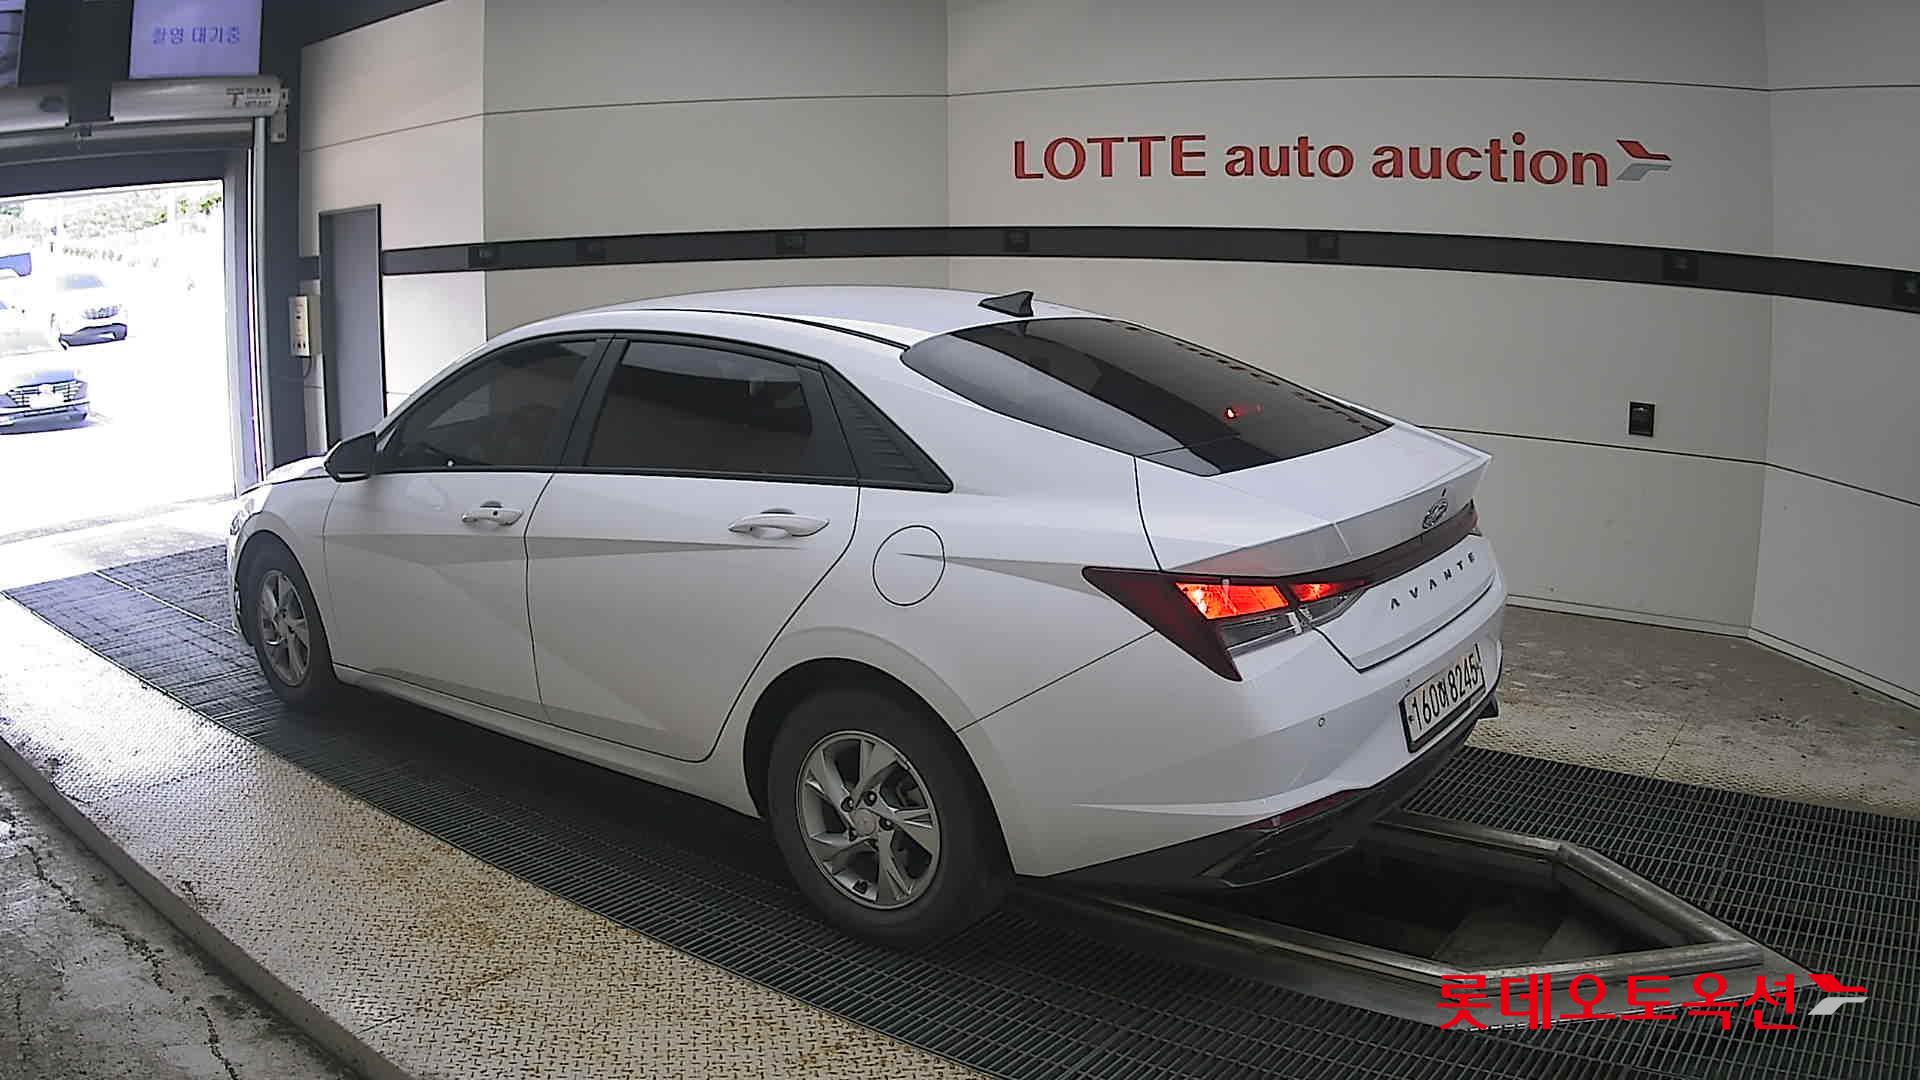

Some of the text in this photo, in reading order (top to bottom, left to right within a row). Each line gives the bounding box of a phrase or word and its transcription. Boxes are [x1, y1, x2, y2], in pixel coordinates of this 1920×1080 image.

[1015, 131, 1608, 187] LOTTE auto auction
[1390, 551, 1476, 610] AVANTE
